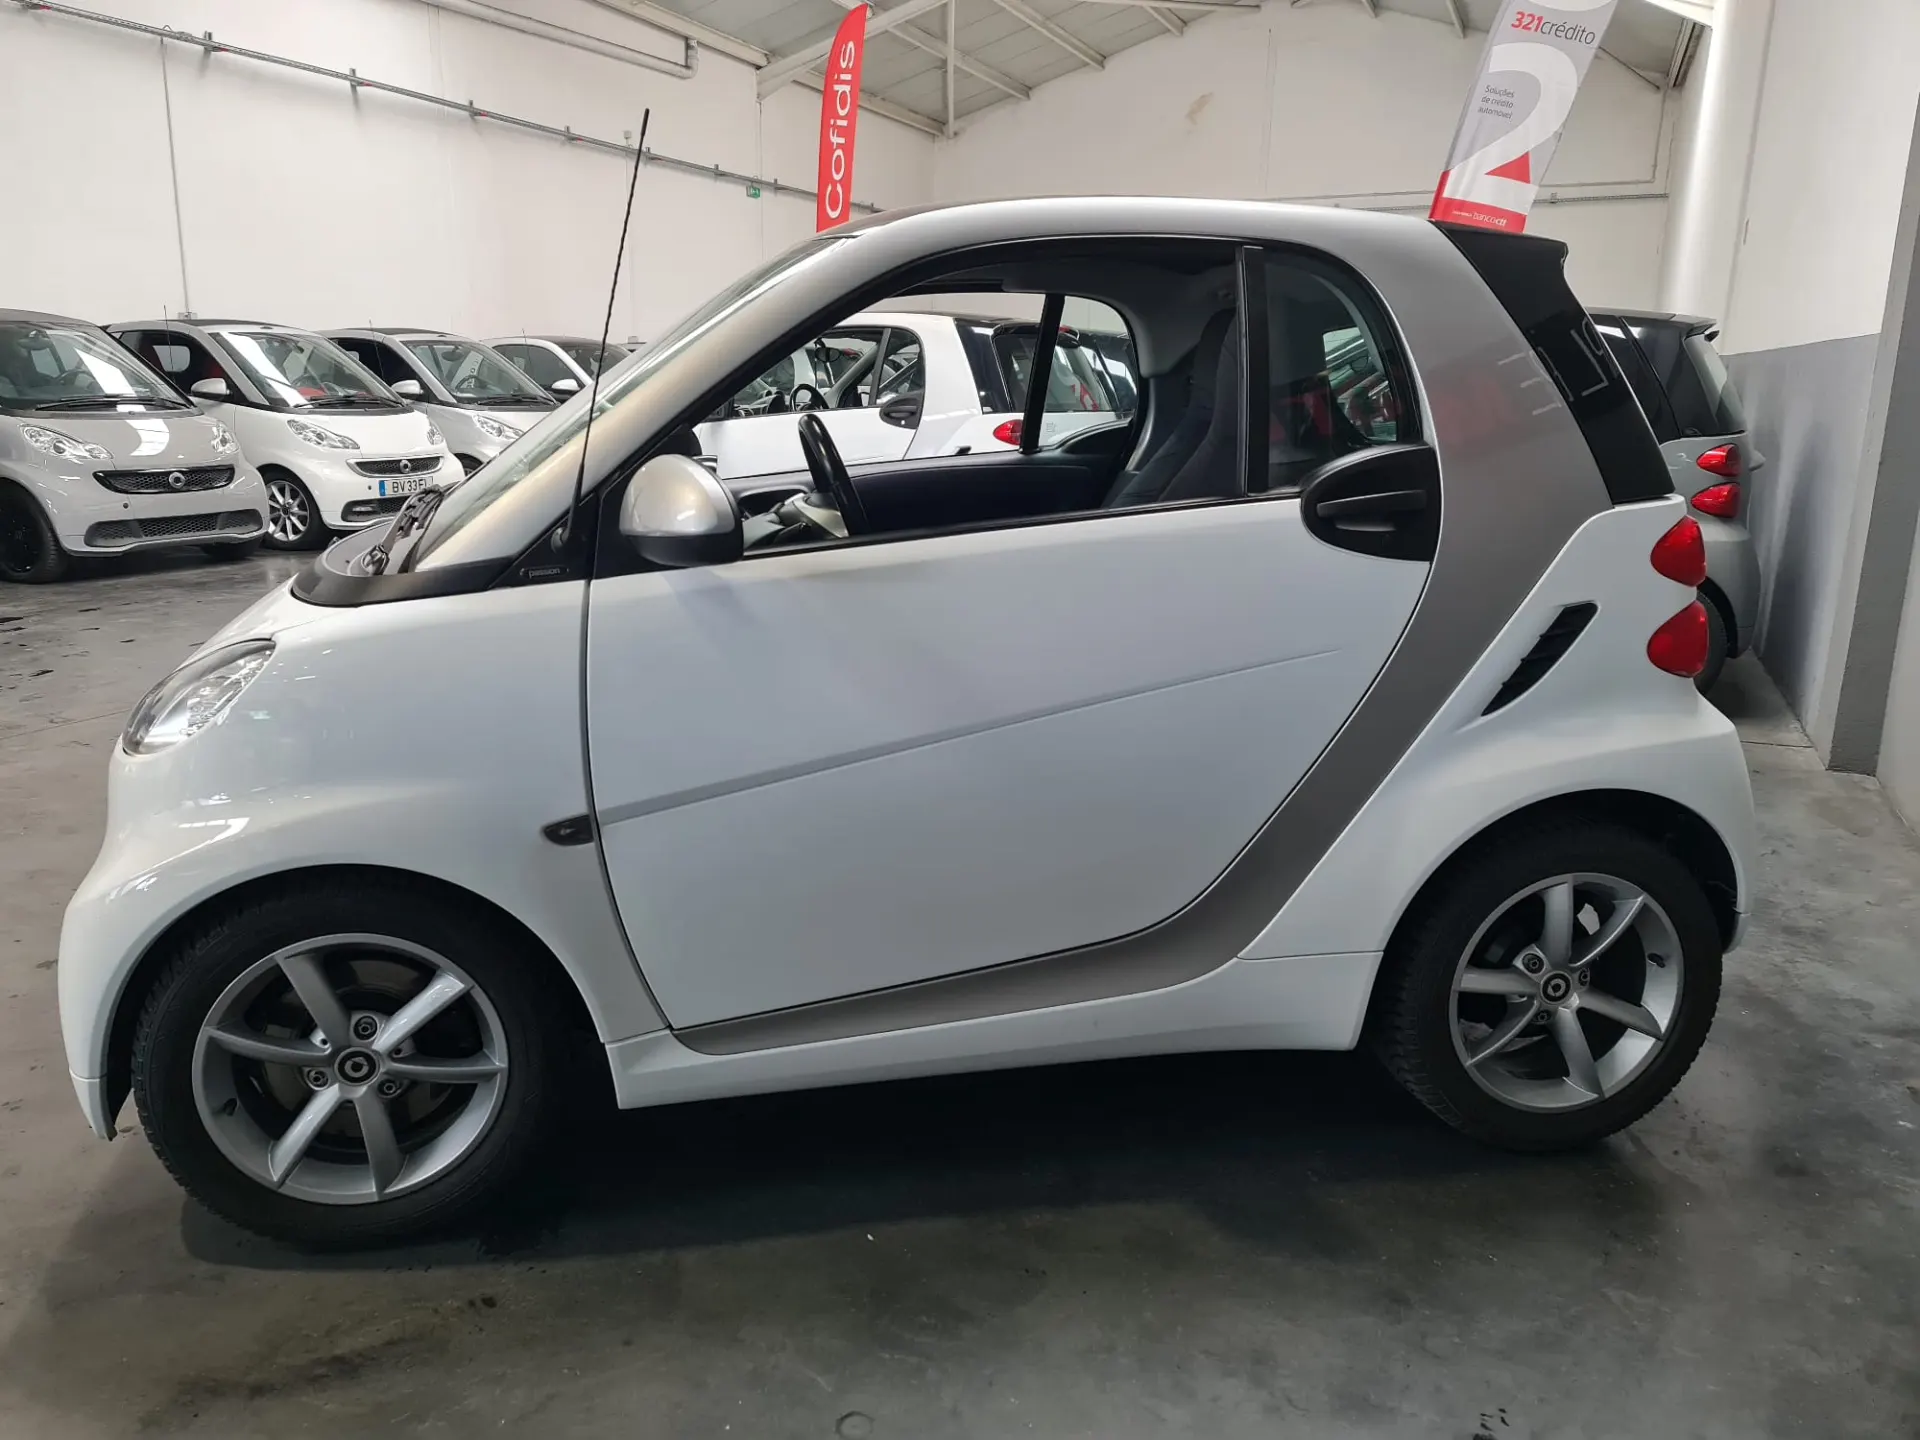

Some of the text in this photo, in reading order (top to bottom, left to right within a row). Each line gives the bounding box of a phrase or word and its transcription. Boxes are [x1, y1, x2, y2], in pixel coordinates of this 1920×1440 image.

[1481, 95, 1491, 104] de
[825, 40, 855, 219] Cofidis
[528, 568, 561, 579] passion
